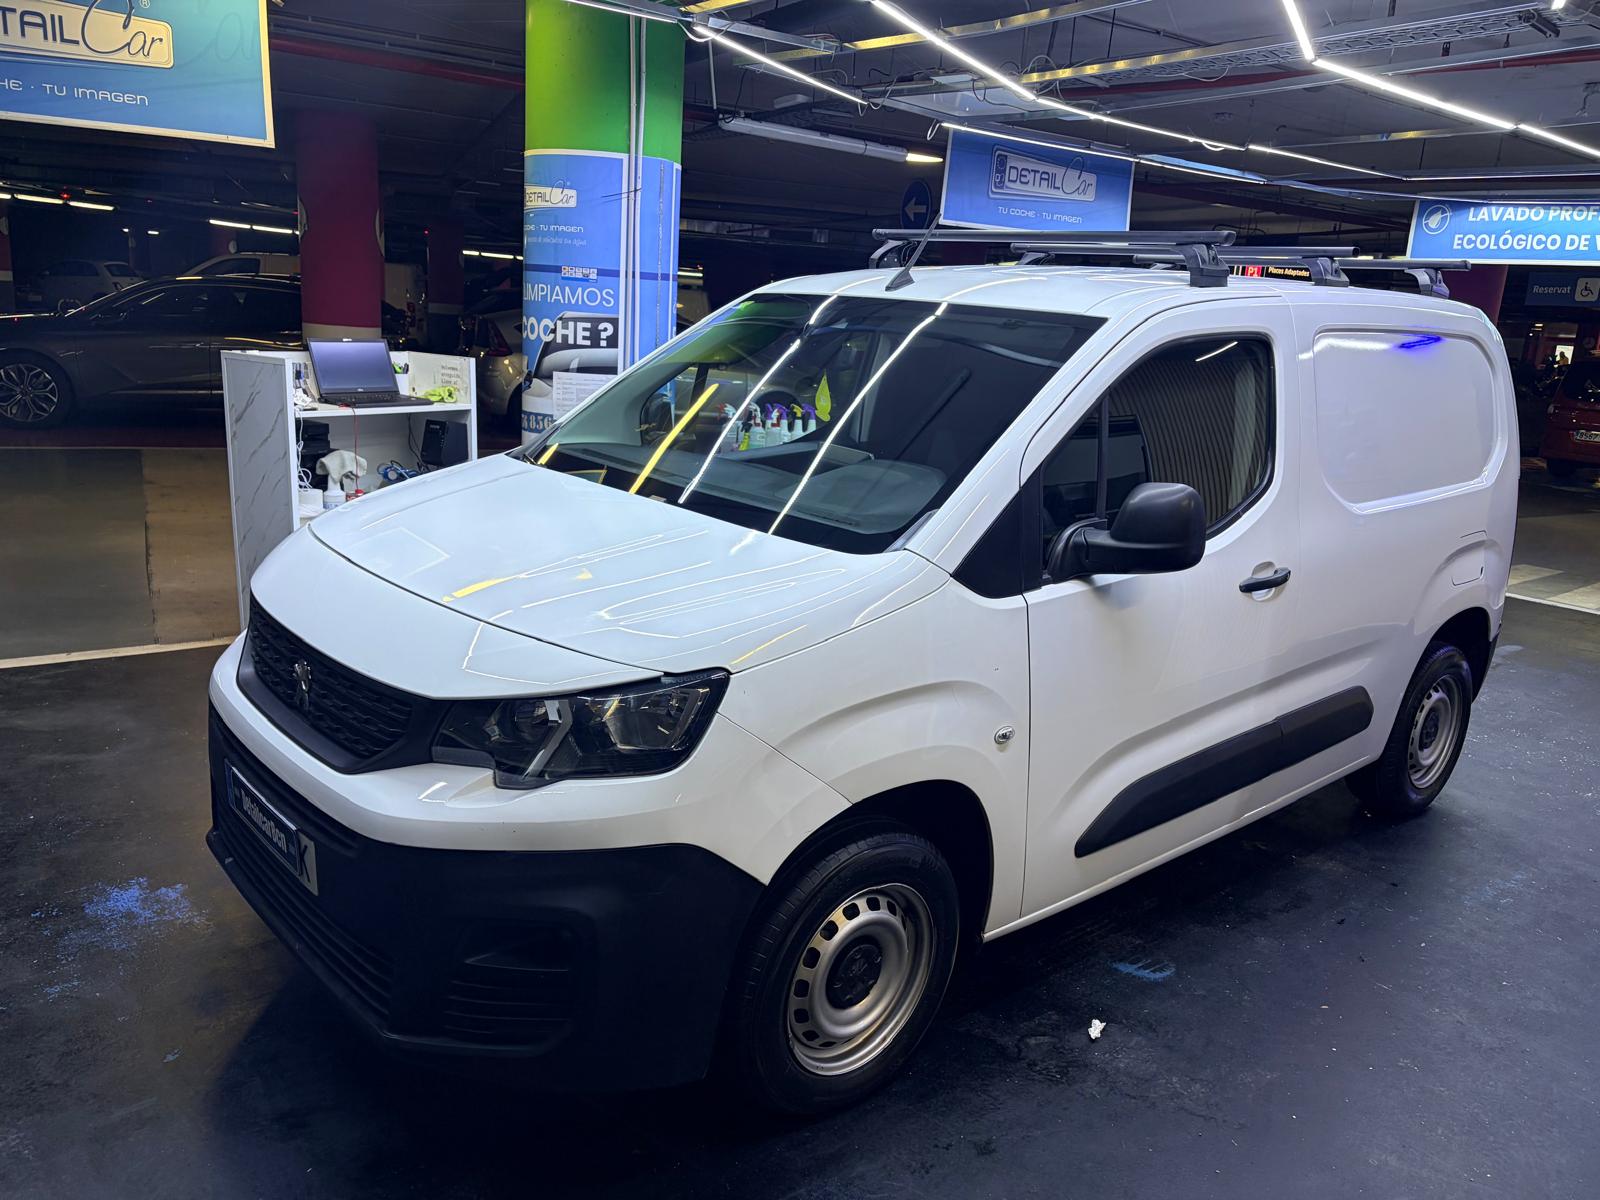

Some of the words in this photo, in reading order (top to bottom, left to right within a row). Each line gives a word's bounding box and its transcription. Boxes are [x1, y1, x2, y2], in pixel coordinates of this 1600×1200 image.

[42, 83, 66, 96] TU
[74, 87, 149, 106] IMAGEN
[1007, 165, 1061, 191] DETAIL
[998, 206, 1008, 214] TU
[1009, 208, 1036, 218] COCHE
[1042, 212, 1052, 220] TU
[1053, 213, 1082, 224] IMAGEN
[1468, 206, 1545, 222] LAVADO
[1548, 205, 1600, 222] PROF
[549, 225, 584, 233] IMAGEN
[1453, 229, 1562, 251] ECOLÓGICO
[1565, 234, 1591, 251] DE
[1533, 285, 1572, 294] Reservat
